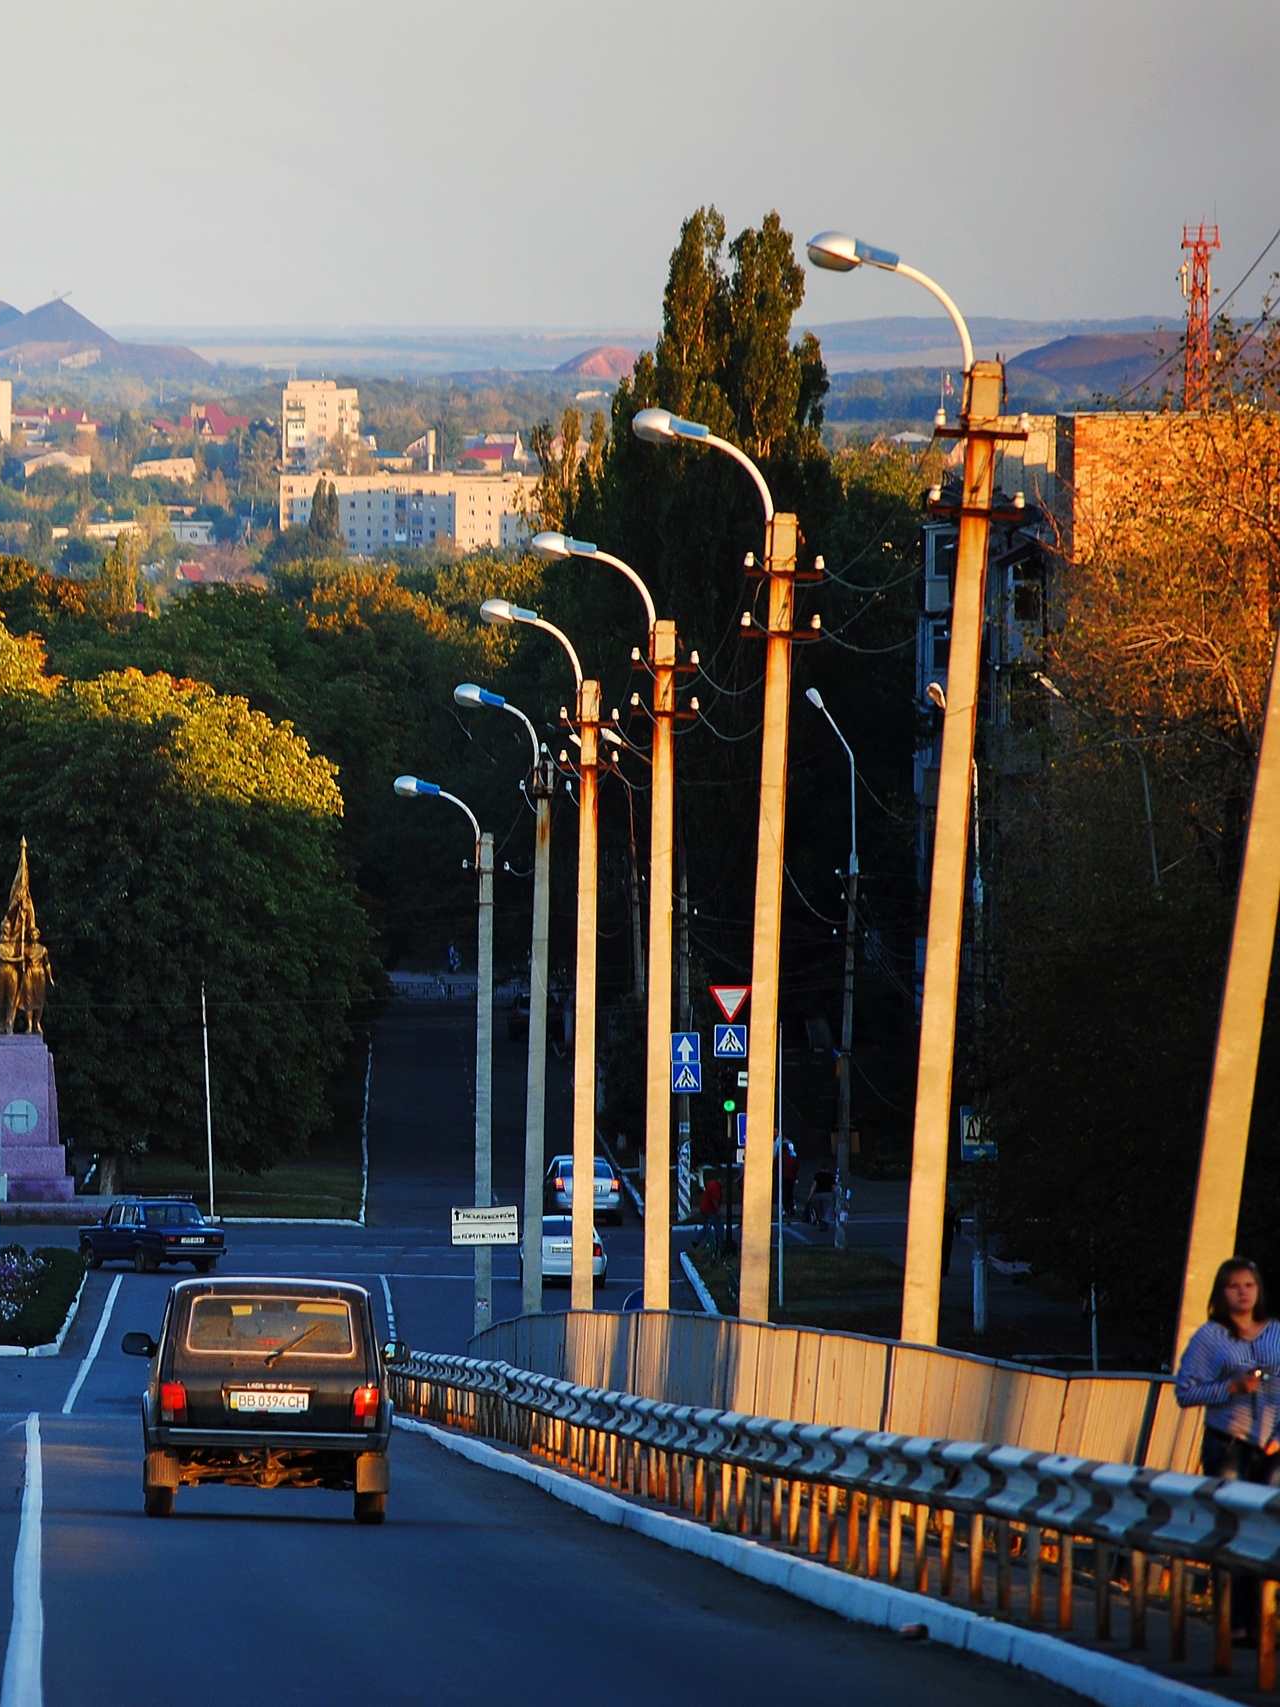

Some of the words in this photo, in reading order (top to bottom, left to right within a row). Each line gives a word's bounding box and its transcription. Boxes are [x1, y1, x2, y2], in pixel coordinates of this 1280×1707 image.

[247, 1382, 265, 1390] LADA
[238, 1394, 256, 1407] BB
[258, 1395, 286, 1408] 0394
[287, 1396, 305, 1408] CH
